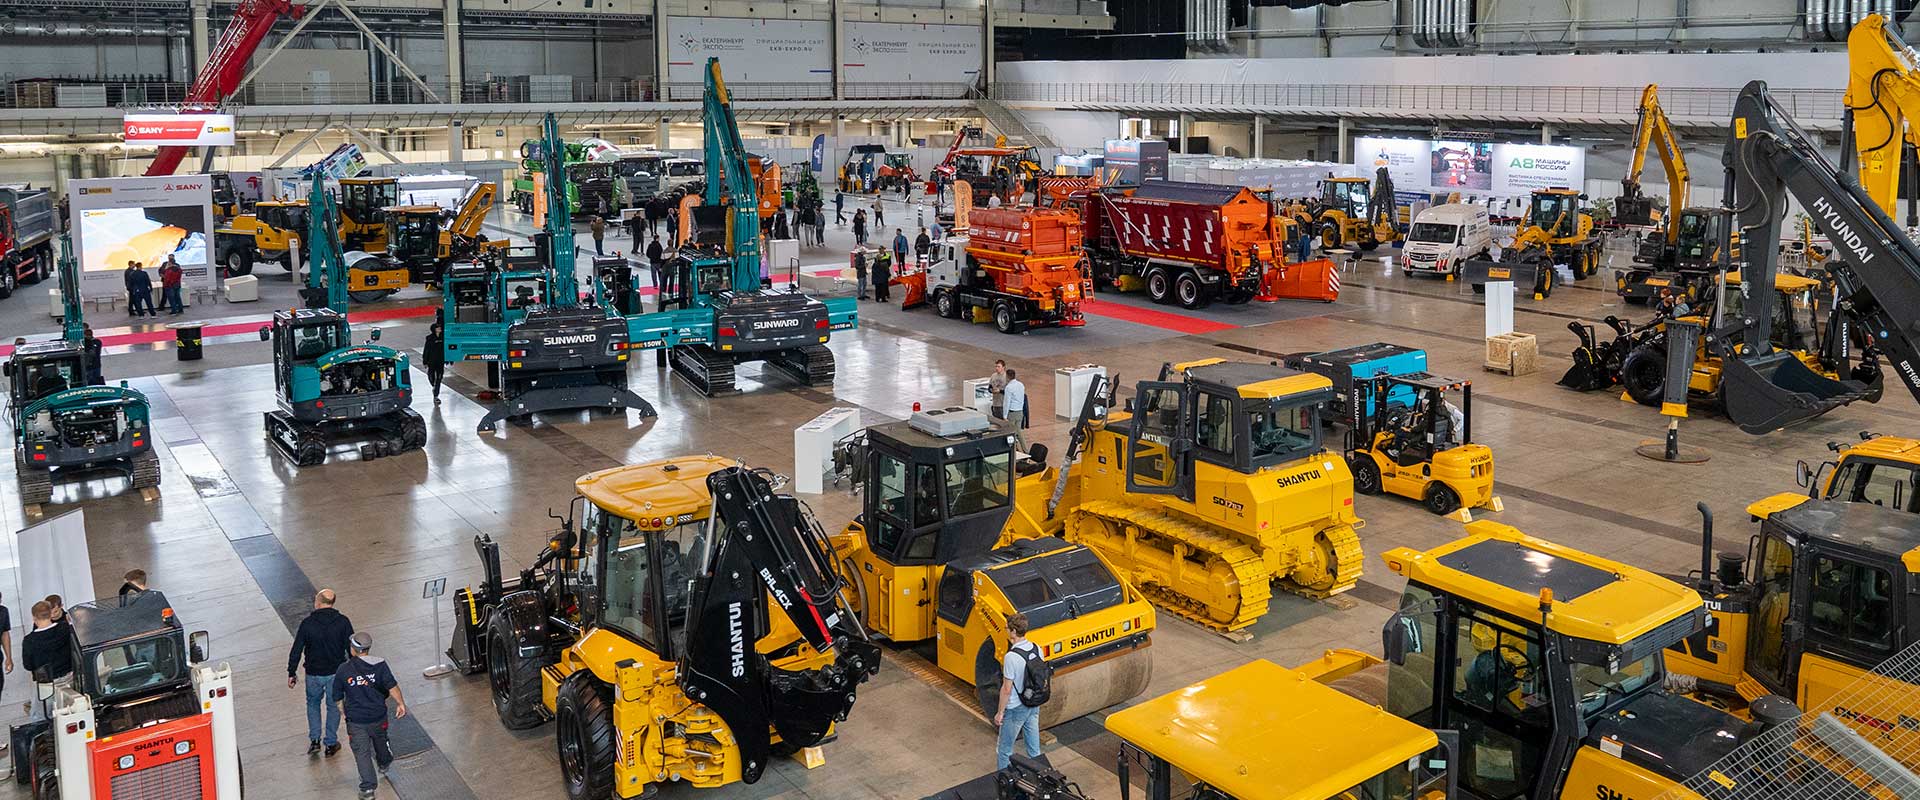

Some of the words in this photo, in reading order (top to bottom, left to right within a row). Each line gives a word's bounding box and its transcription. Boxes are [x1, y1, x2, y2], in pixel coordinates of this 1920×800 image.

[1813, 196, 1875, 264] HYUNDAI
[750, 319, 799, 330] SUNWARD
[543, 334, 596, 346] SUNWARD
[338, 348, 382, 357] SUNWARD
[56, 388, 115, 400] SUNWARD
[1141, 432, 1162, 443] ANTUI
[1470, 454, 1490, 464] HYUNDAI
[1276, 470, 1321, 488] SHANTUI
[729, 602, 744, 678] SHANTUI
[1070, 628, 1115, 649] SHANTUI
[134, 737, 174, 751] SHANTUI
